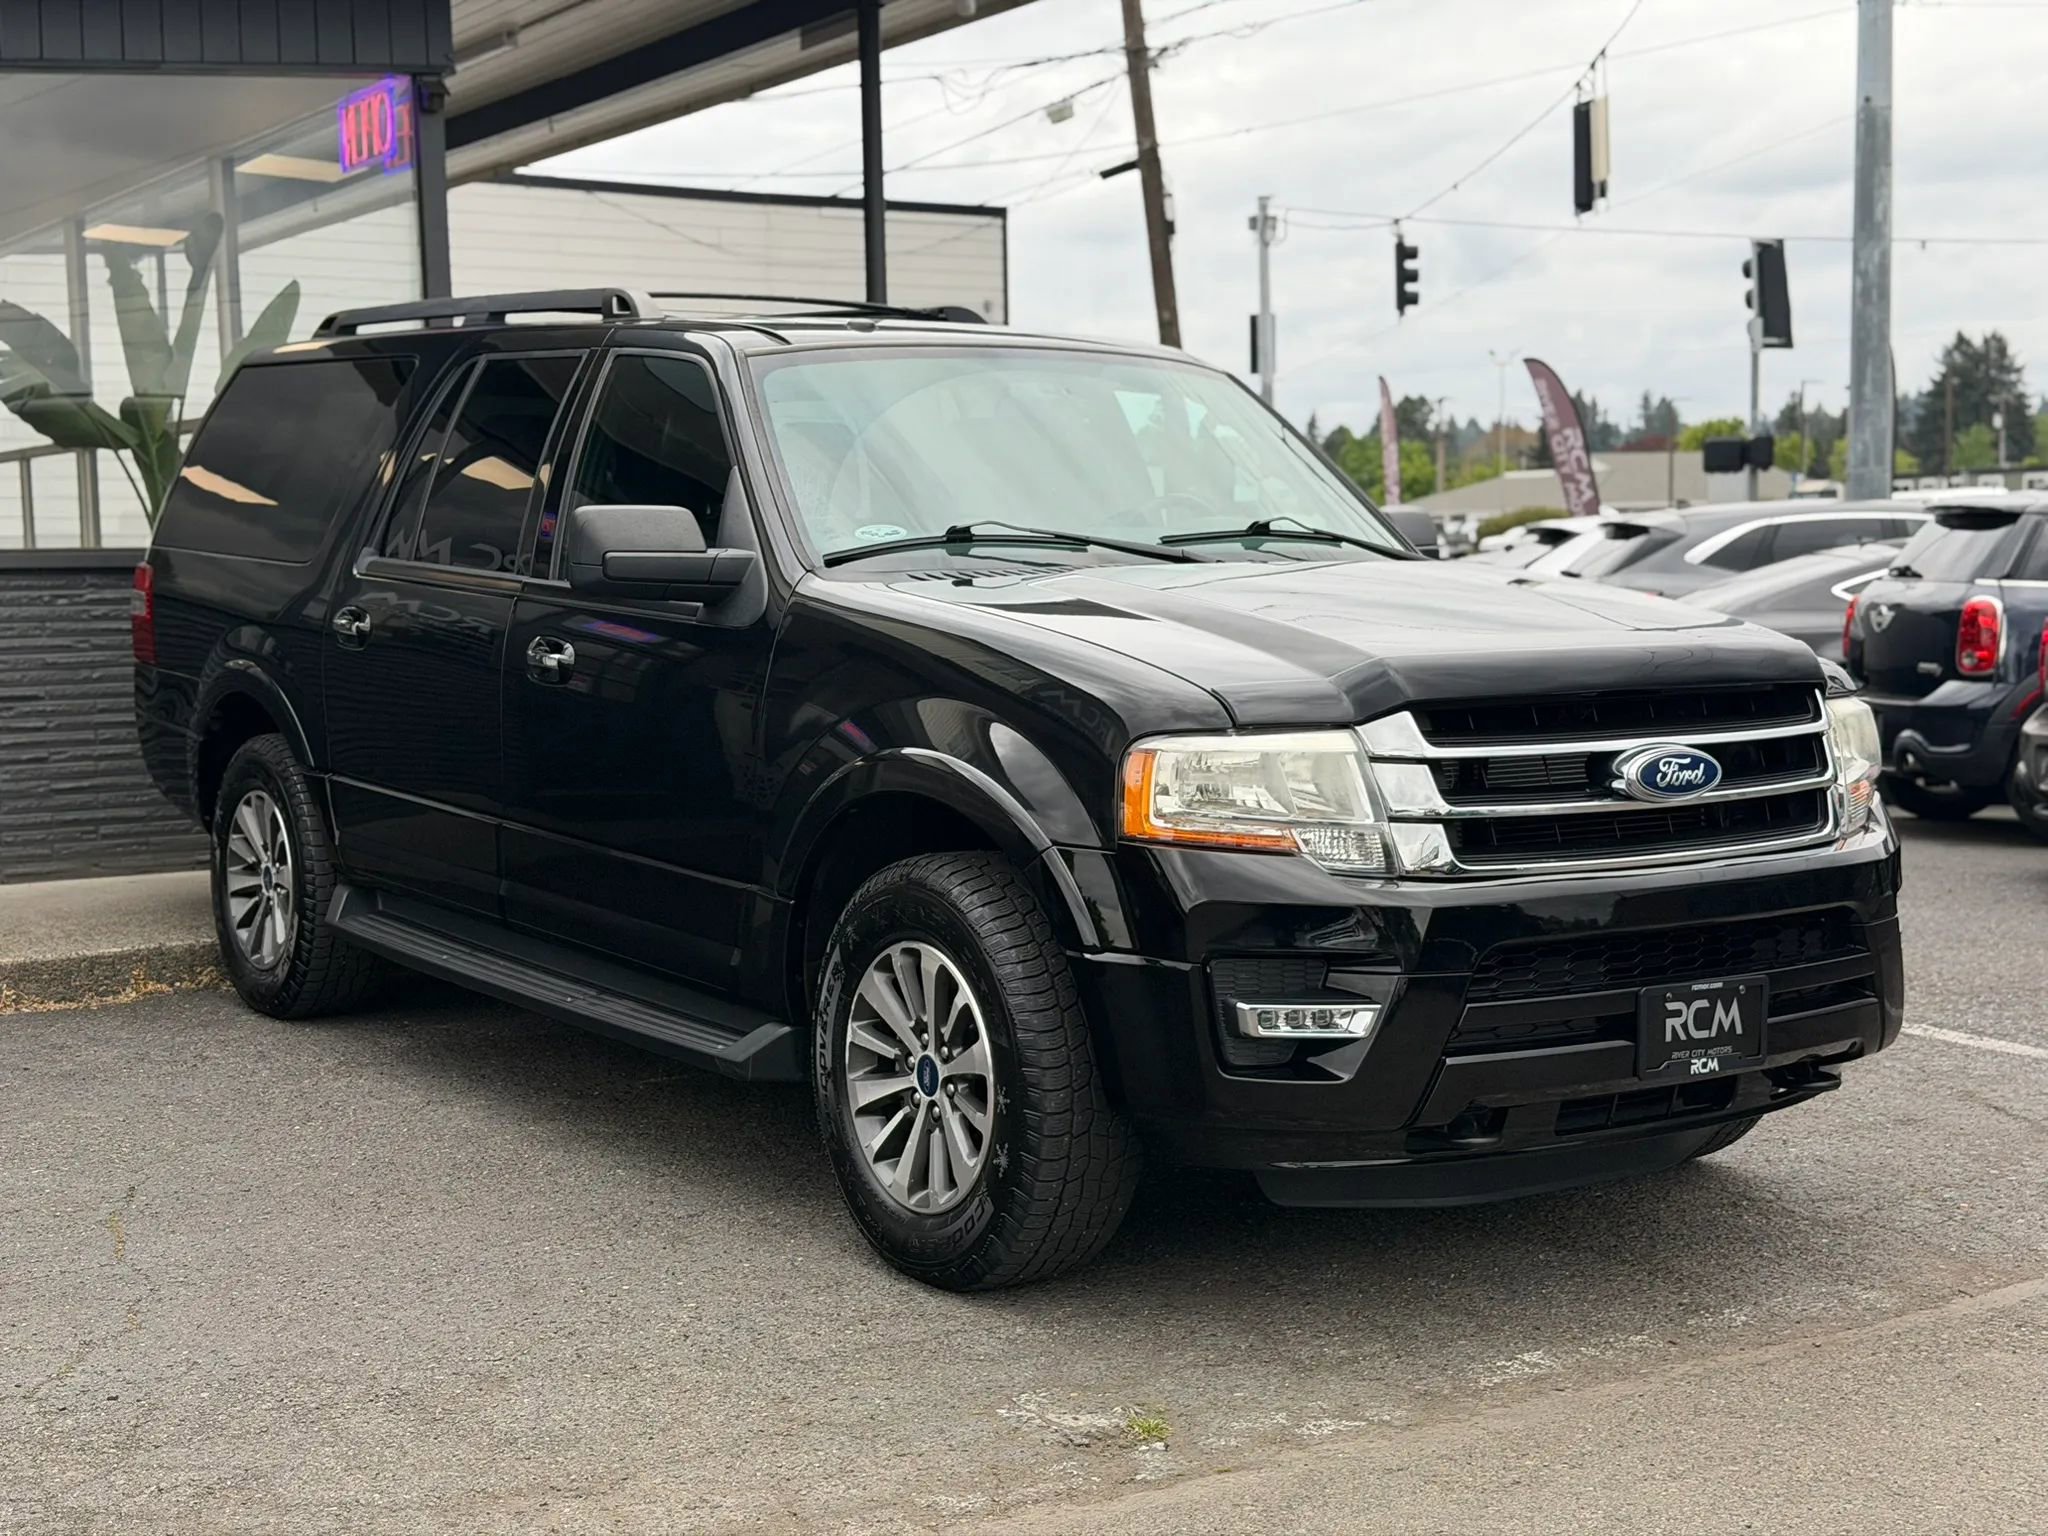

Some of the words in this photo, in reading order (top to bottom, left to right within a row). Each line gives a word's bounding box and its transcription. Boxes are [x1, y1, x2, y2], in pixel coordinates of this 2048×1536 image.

[1561, 426, 1596, 504] RCM
[1656, 757, 1705, 788] Ford
[1664, 997, 1743, 1042] RCM
[1671, 1051, 1690, 1059] RIVER
[1691, 1049, 1706, 1057] CITY
[1706, 1045, 1733, 1056] MOTORS
[1690, 1058, 1719, 1075] RCM
